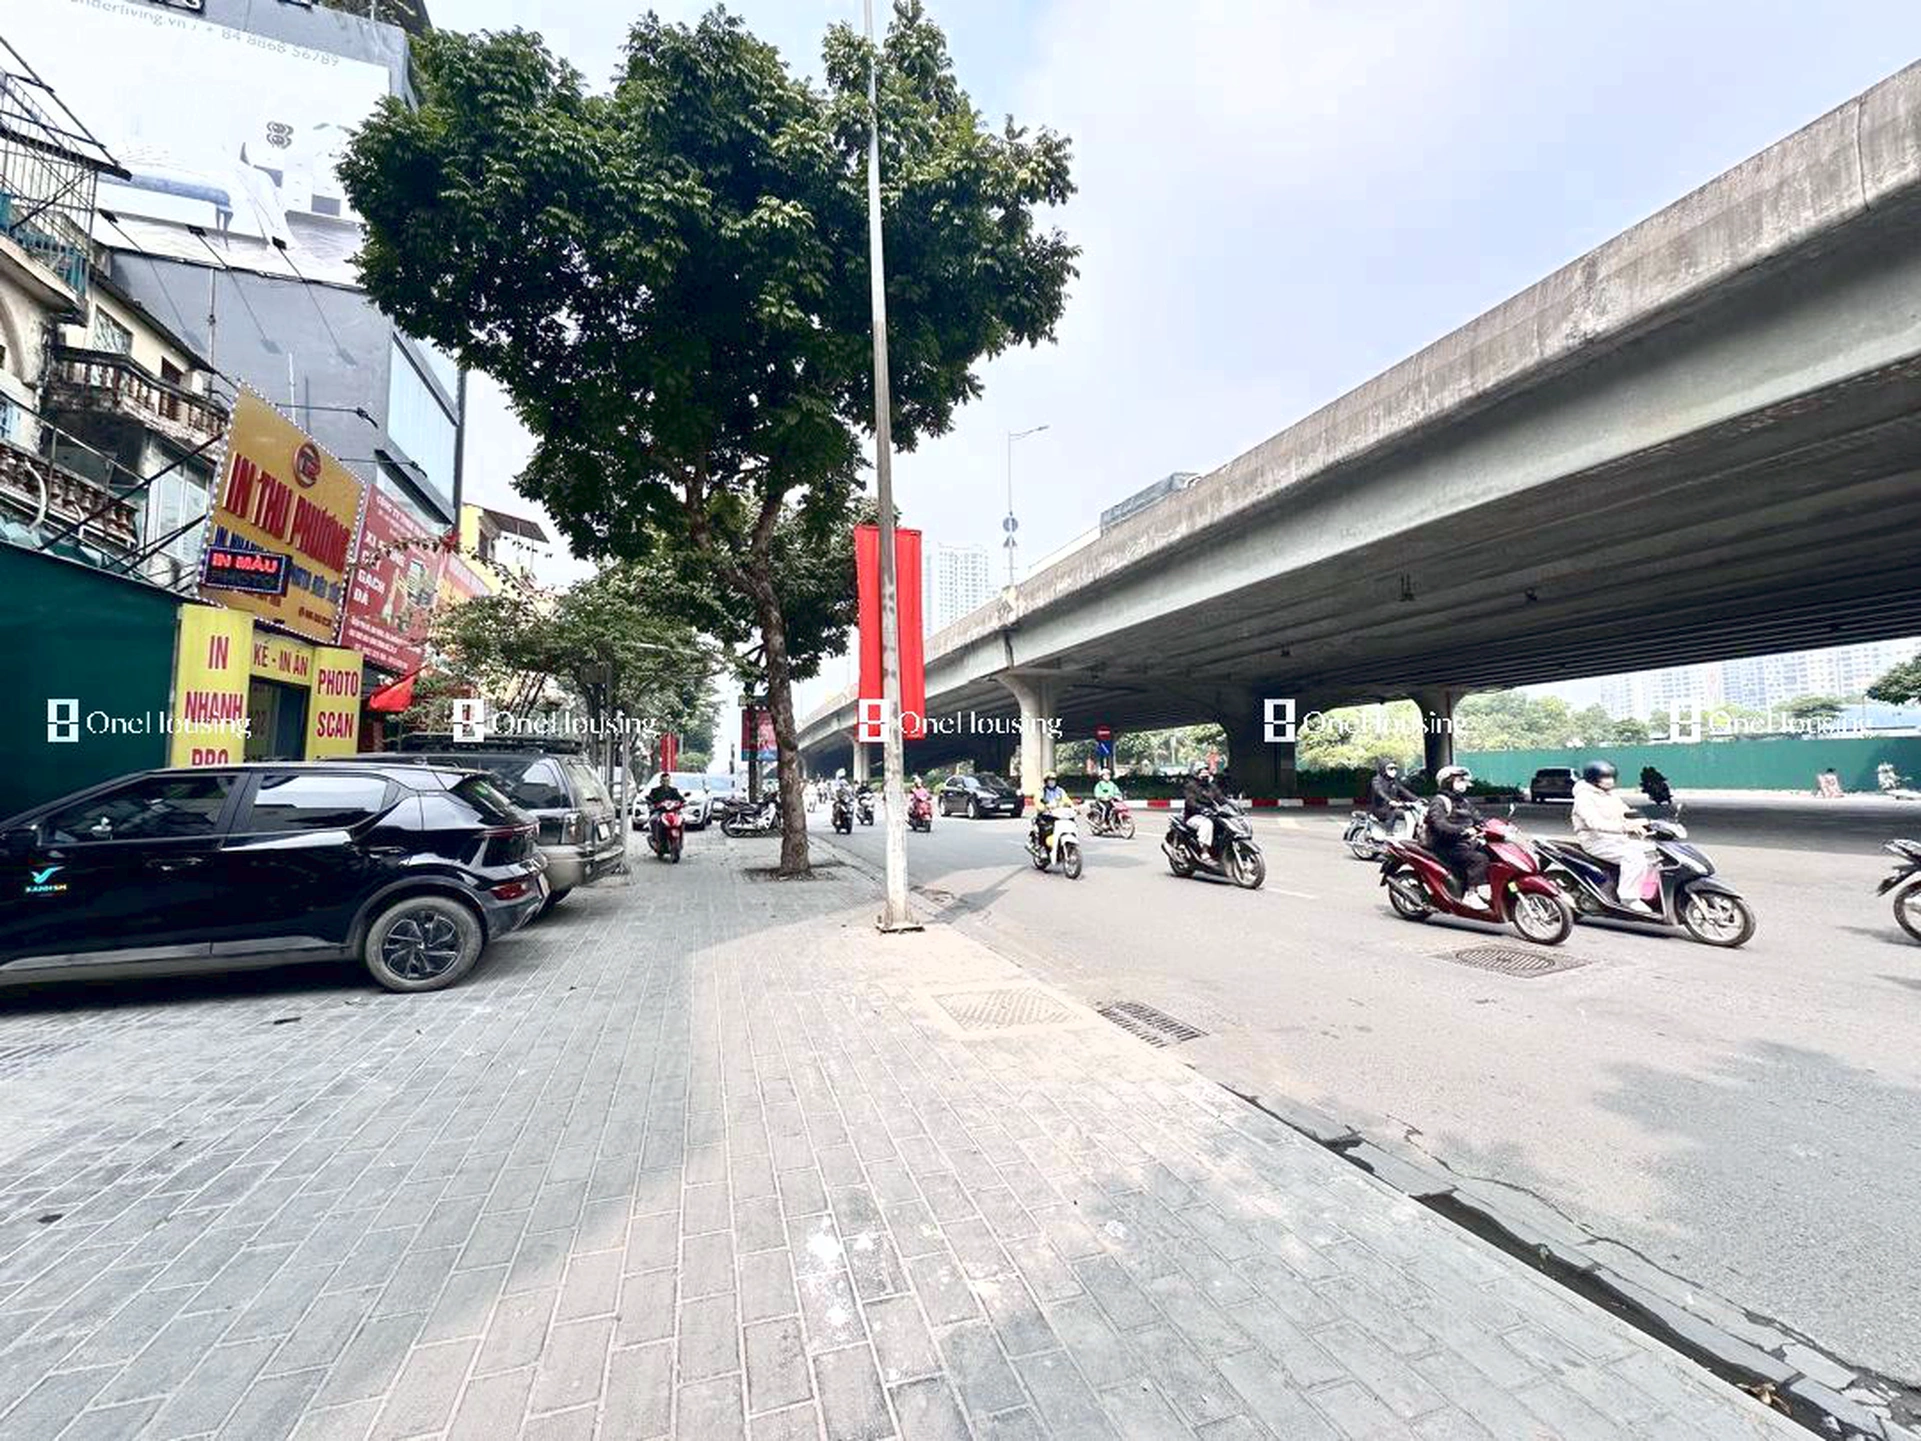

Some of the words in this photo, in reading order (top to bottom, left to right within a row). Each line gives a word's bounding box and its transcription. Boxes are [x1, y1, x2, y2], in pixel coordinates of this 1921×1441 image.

[222, 450, 257, 519] IN
[211, 552, 231, 568] IN
[208, 634, 230, 670] IN
[317, 668, 359, 698] PHOTO
[184, 690, 244, 725] NHANH
[316, 710, 355, 739] SCAN
